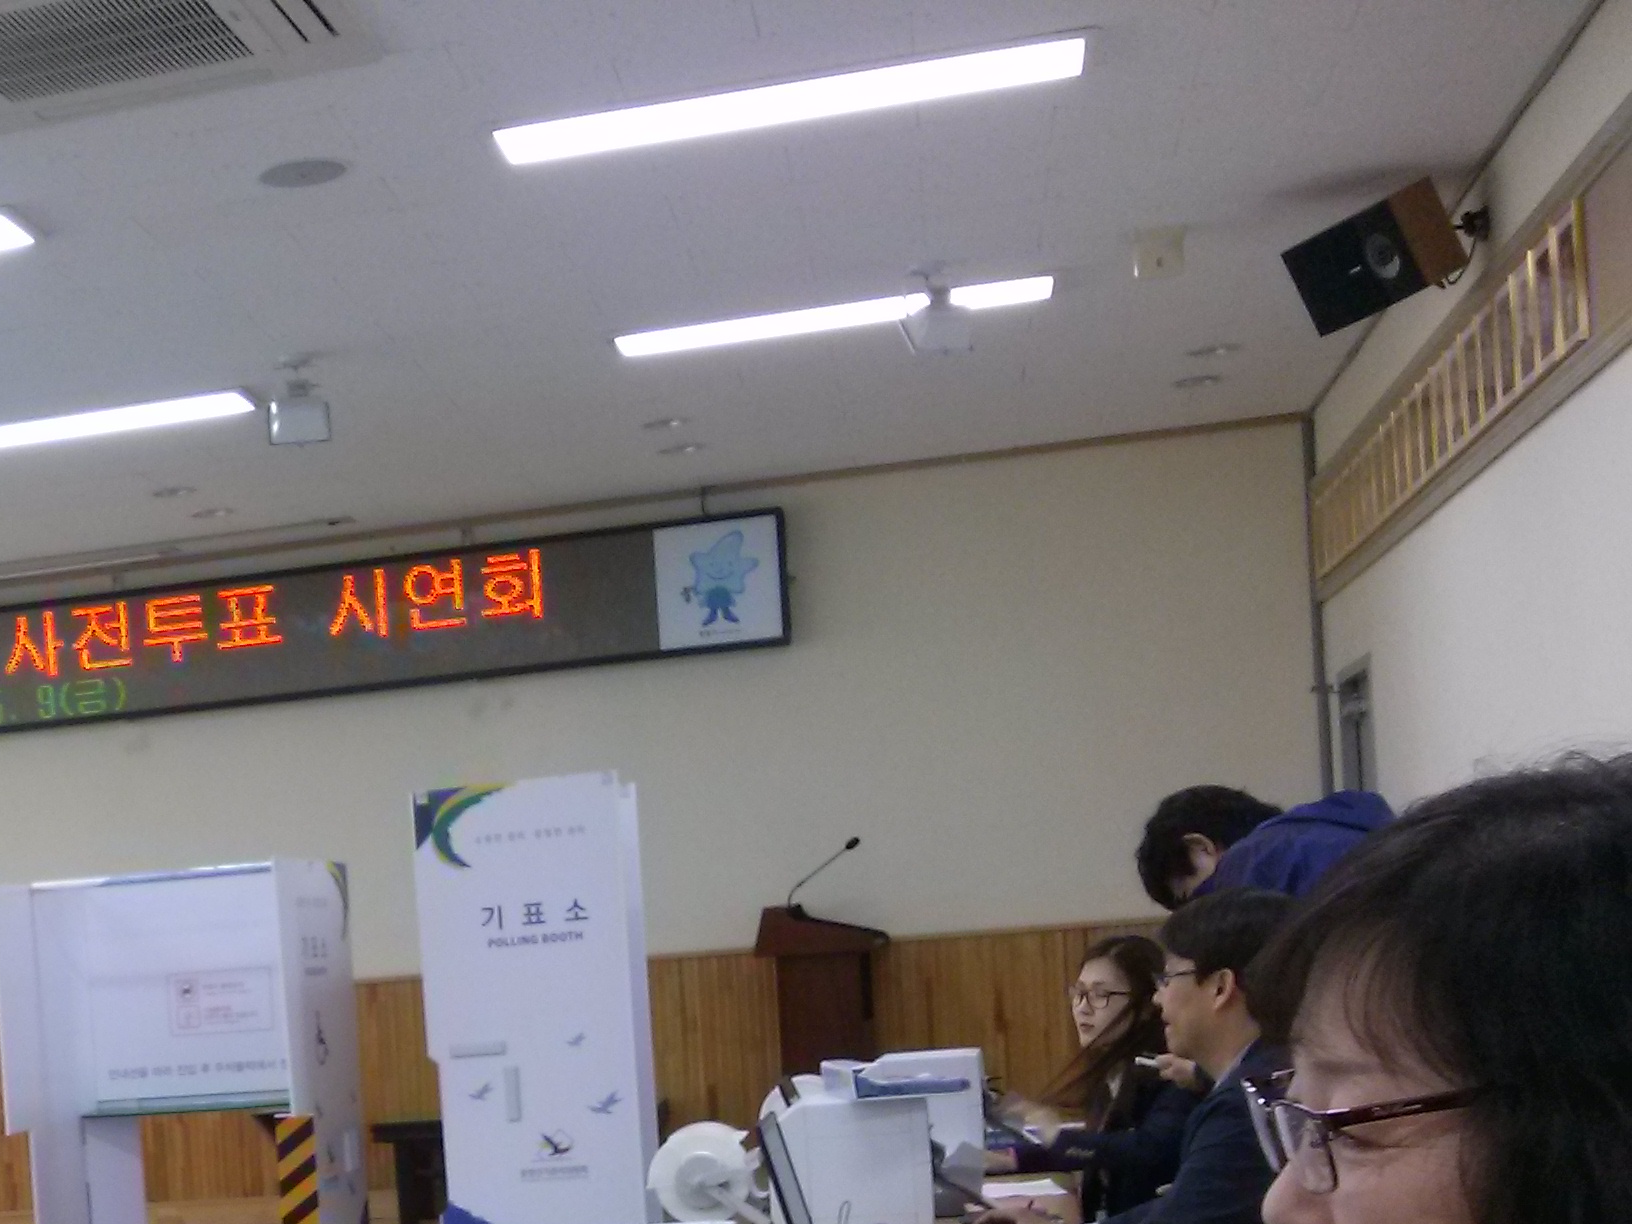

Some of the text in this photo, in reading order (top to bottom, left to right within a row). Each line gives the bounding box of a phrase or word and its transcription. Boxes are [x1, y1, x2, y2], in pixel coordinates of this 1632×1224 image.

[5, 585, 284, 678] 사전투표
[330, 548, 544, 637] 시연회
[36, 677, 127, 720] 9(금)
[481, 898, 590, 931] 기표소
[487, 931, 584, 948] POLLING BOOTH
